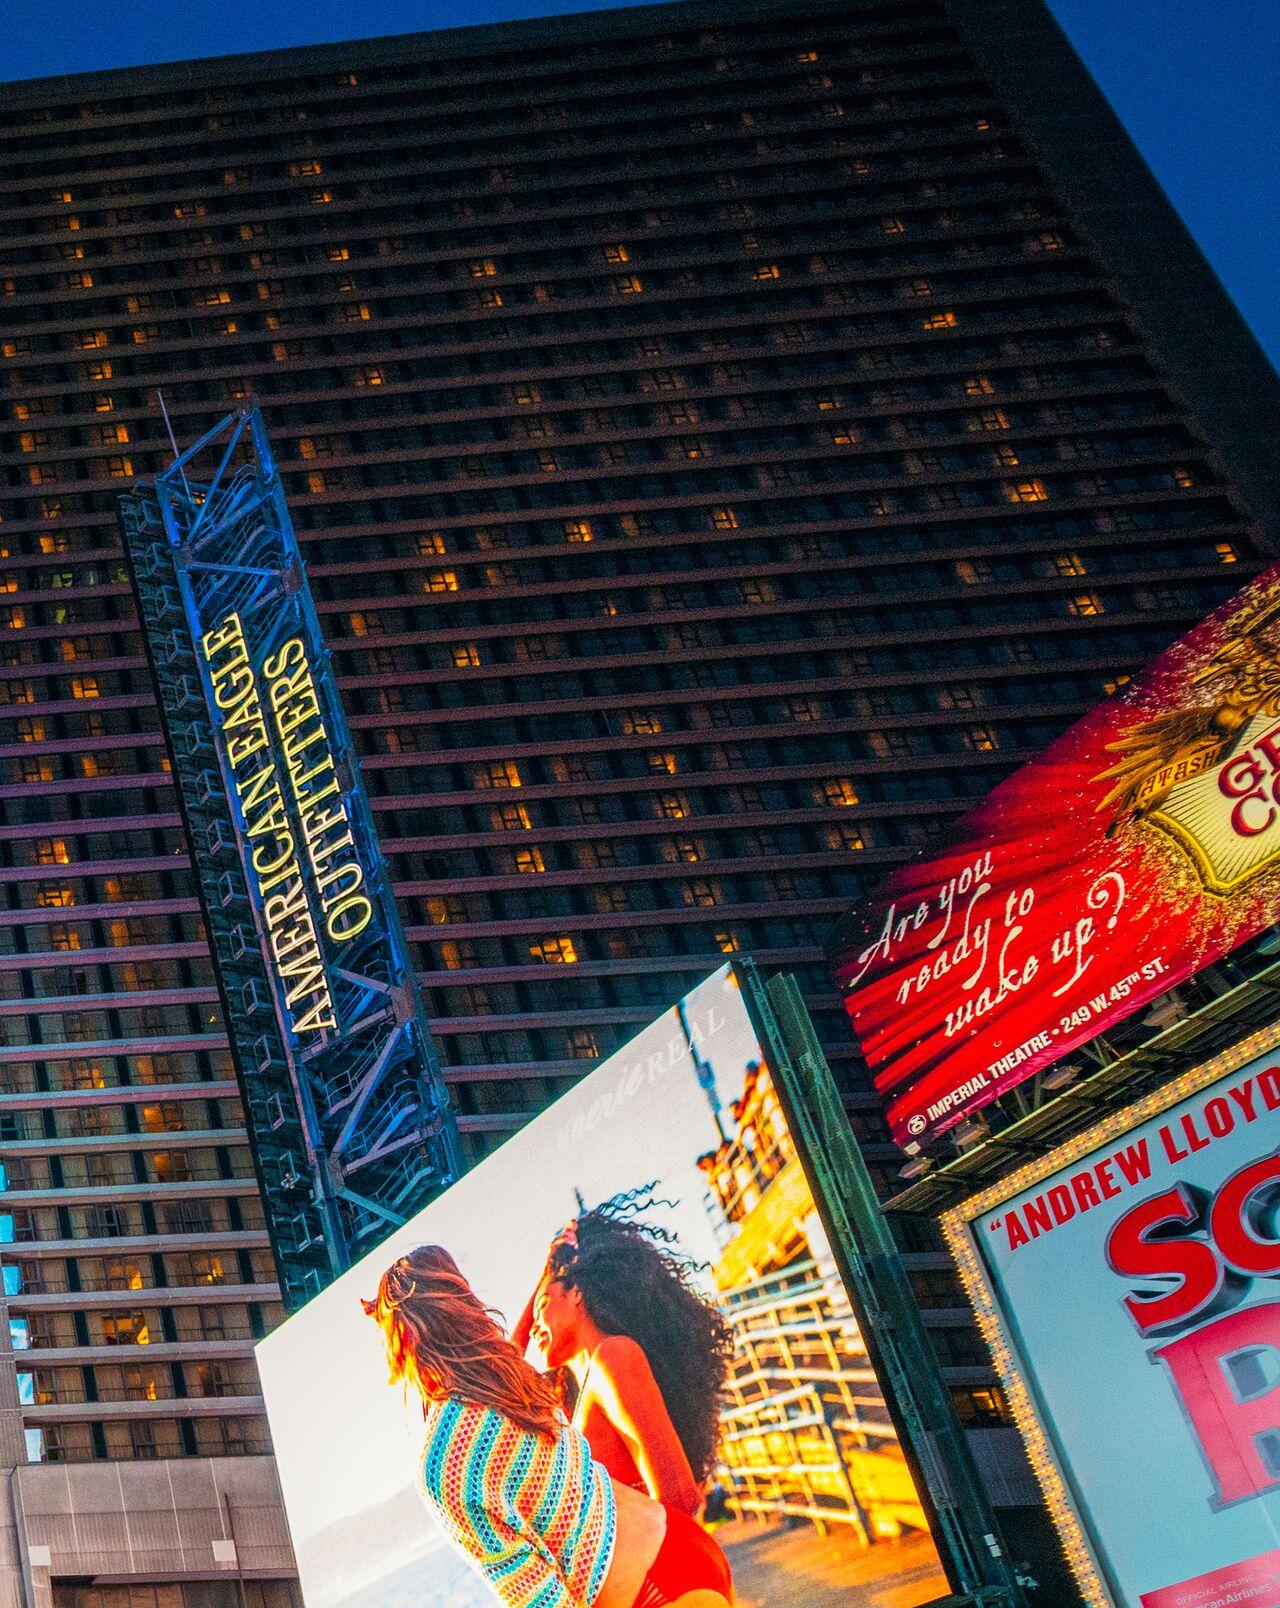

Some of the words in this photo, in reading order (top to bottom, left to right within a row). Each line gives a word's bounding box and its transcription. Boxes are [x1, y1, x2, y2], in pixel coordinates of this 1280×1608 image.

[202, 612, 270, 770] EAGLE
[262, 637, 374, 942] OUTFITTERS
[235, 763, 337, 1034] AMERICAN
[895, 882, 992, 1006] ready
[1003, 885, 1036, 929] to
[927, 850, 995, 951] you
[925, 1072, 991, 1123] IMPERIAL
[987, 1030, 1055, 1090] THEATRE
[1059, 1003, 1094, 1035] 249
[1158, 1062, 1280, 1167] LLOYD
